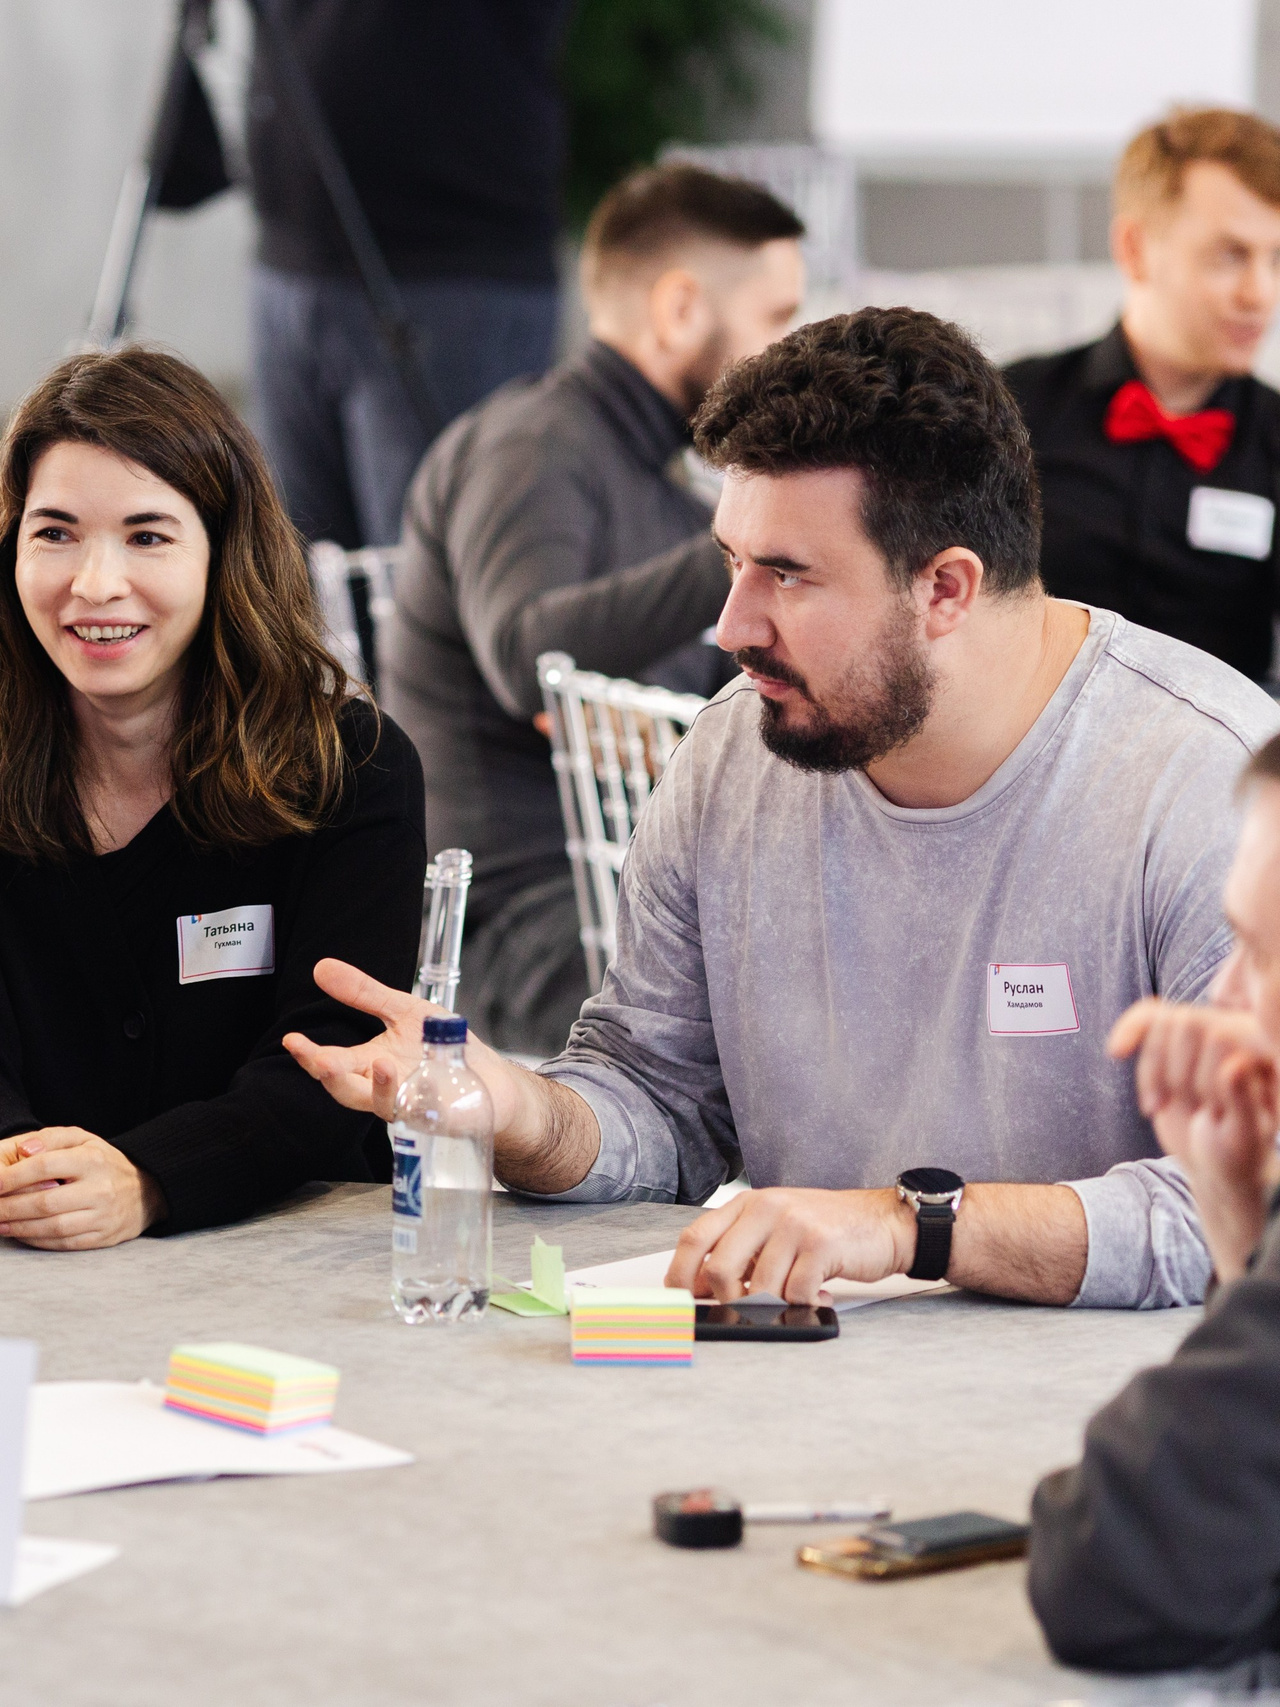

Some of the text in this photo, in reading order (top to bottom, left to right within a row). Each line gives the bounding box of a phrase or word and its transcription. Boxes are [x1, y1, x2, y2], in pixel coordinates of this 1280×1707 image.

[204, 922, 255, 938] Татьяна
[214, 940, 242, 949] Гухман
[1003, 981, 1044, 997] Руслан
[1006, 1000, 1044, 1009] Хамдамов
